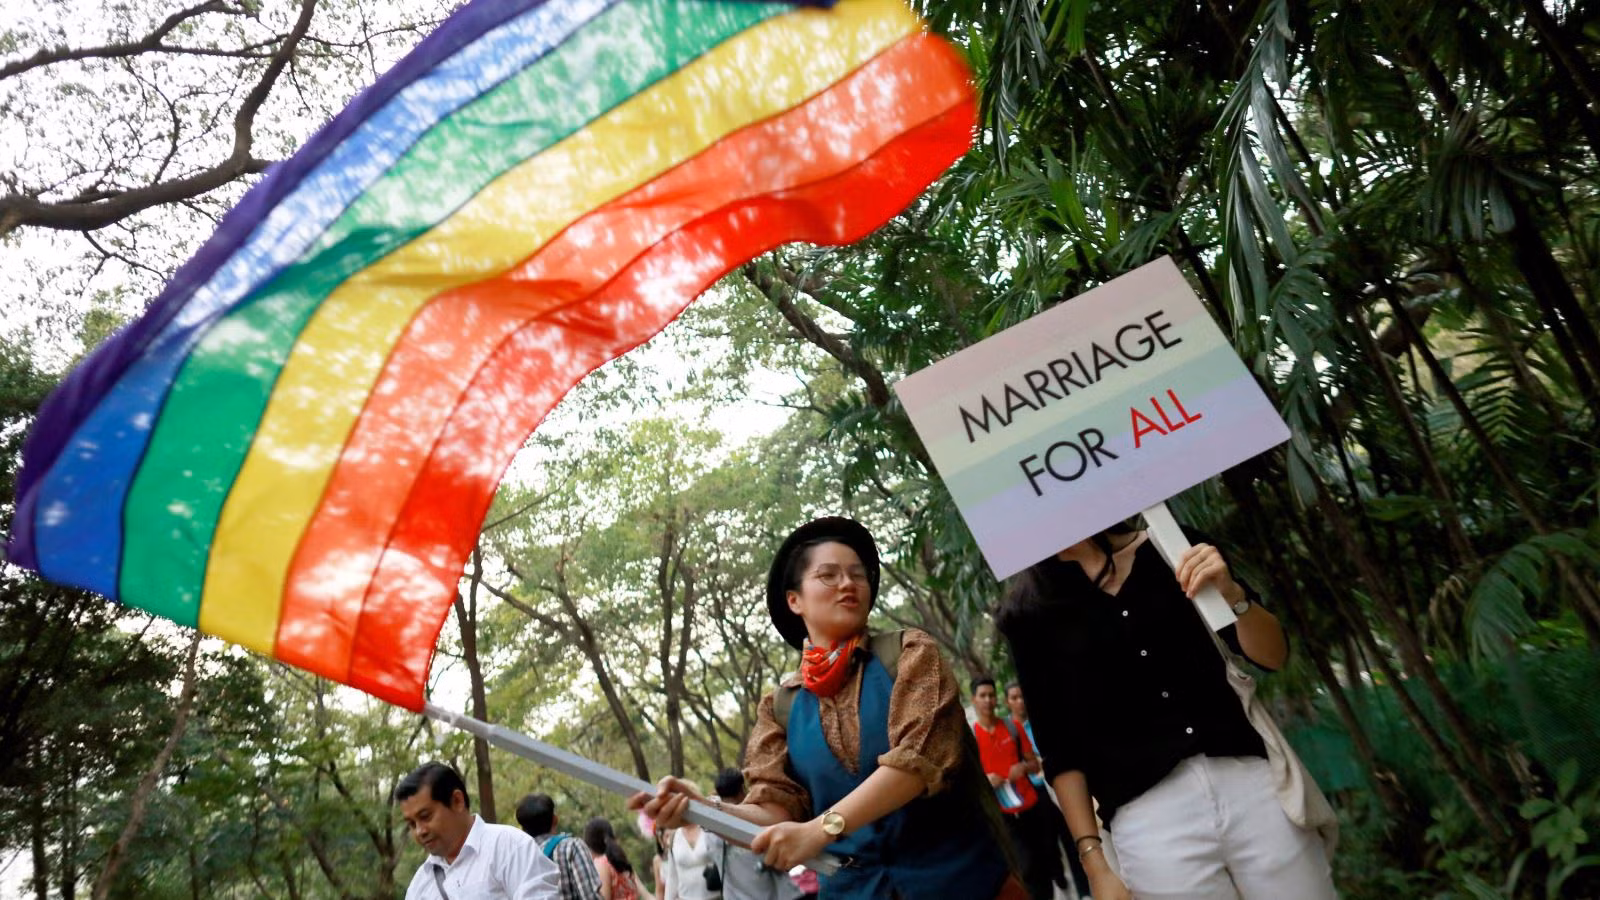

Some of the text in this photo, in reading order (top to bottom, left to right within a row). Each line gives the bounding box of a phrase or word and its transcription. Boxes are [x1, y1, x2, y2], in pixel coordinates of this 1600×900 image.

[958, 309, 1183, 443] MARRIAGE
[1018, 388, 1202, 497] FOR ALL
